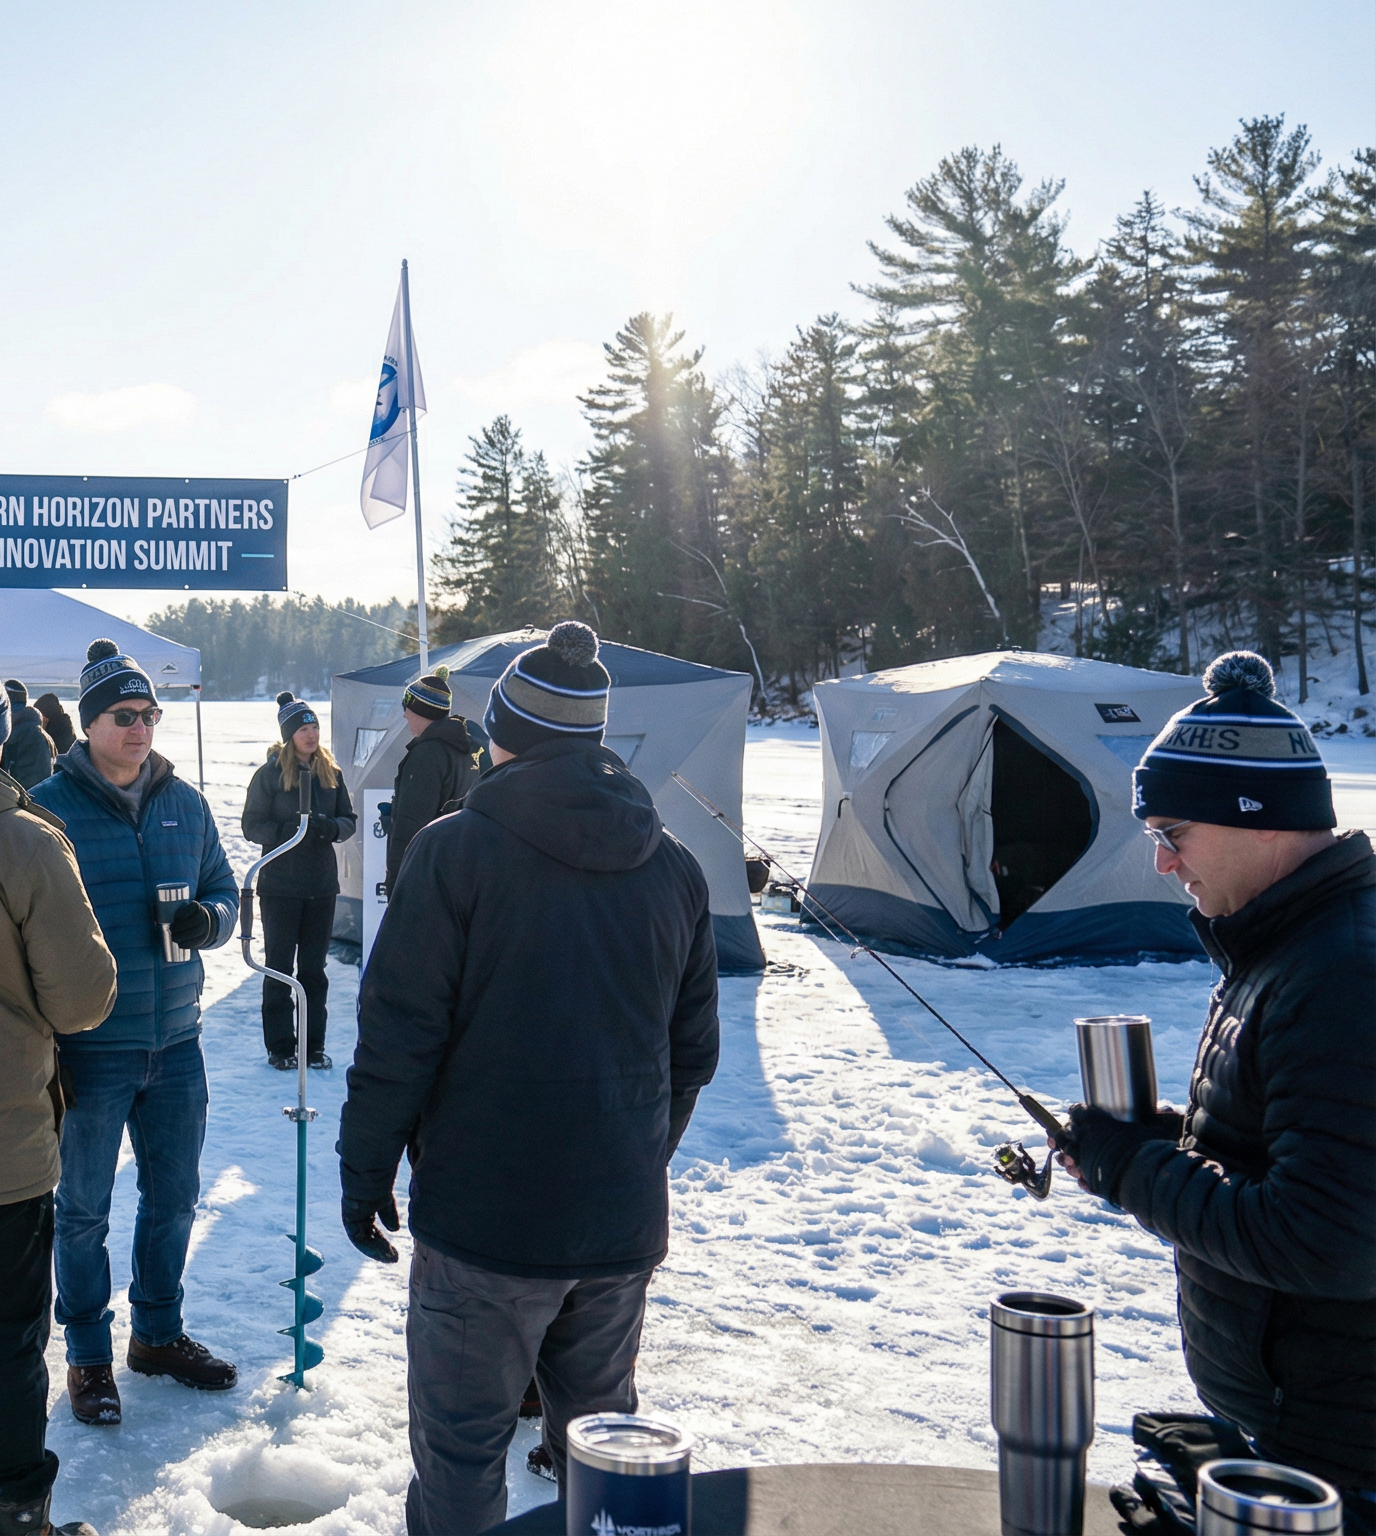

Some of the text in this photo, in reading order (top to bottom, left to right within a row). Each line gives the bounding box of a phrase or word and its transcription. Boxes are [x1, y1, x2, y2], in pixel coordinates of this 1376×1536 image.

[33, 496, 139, 528] HORIZON
[147, 498, 274, 530] PARTNERS
[133, 540, 232, 571] SUMMIT
